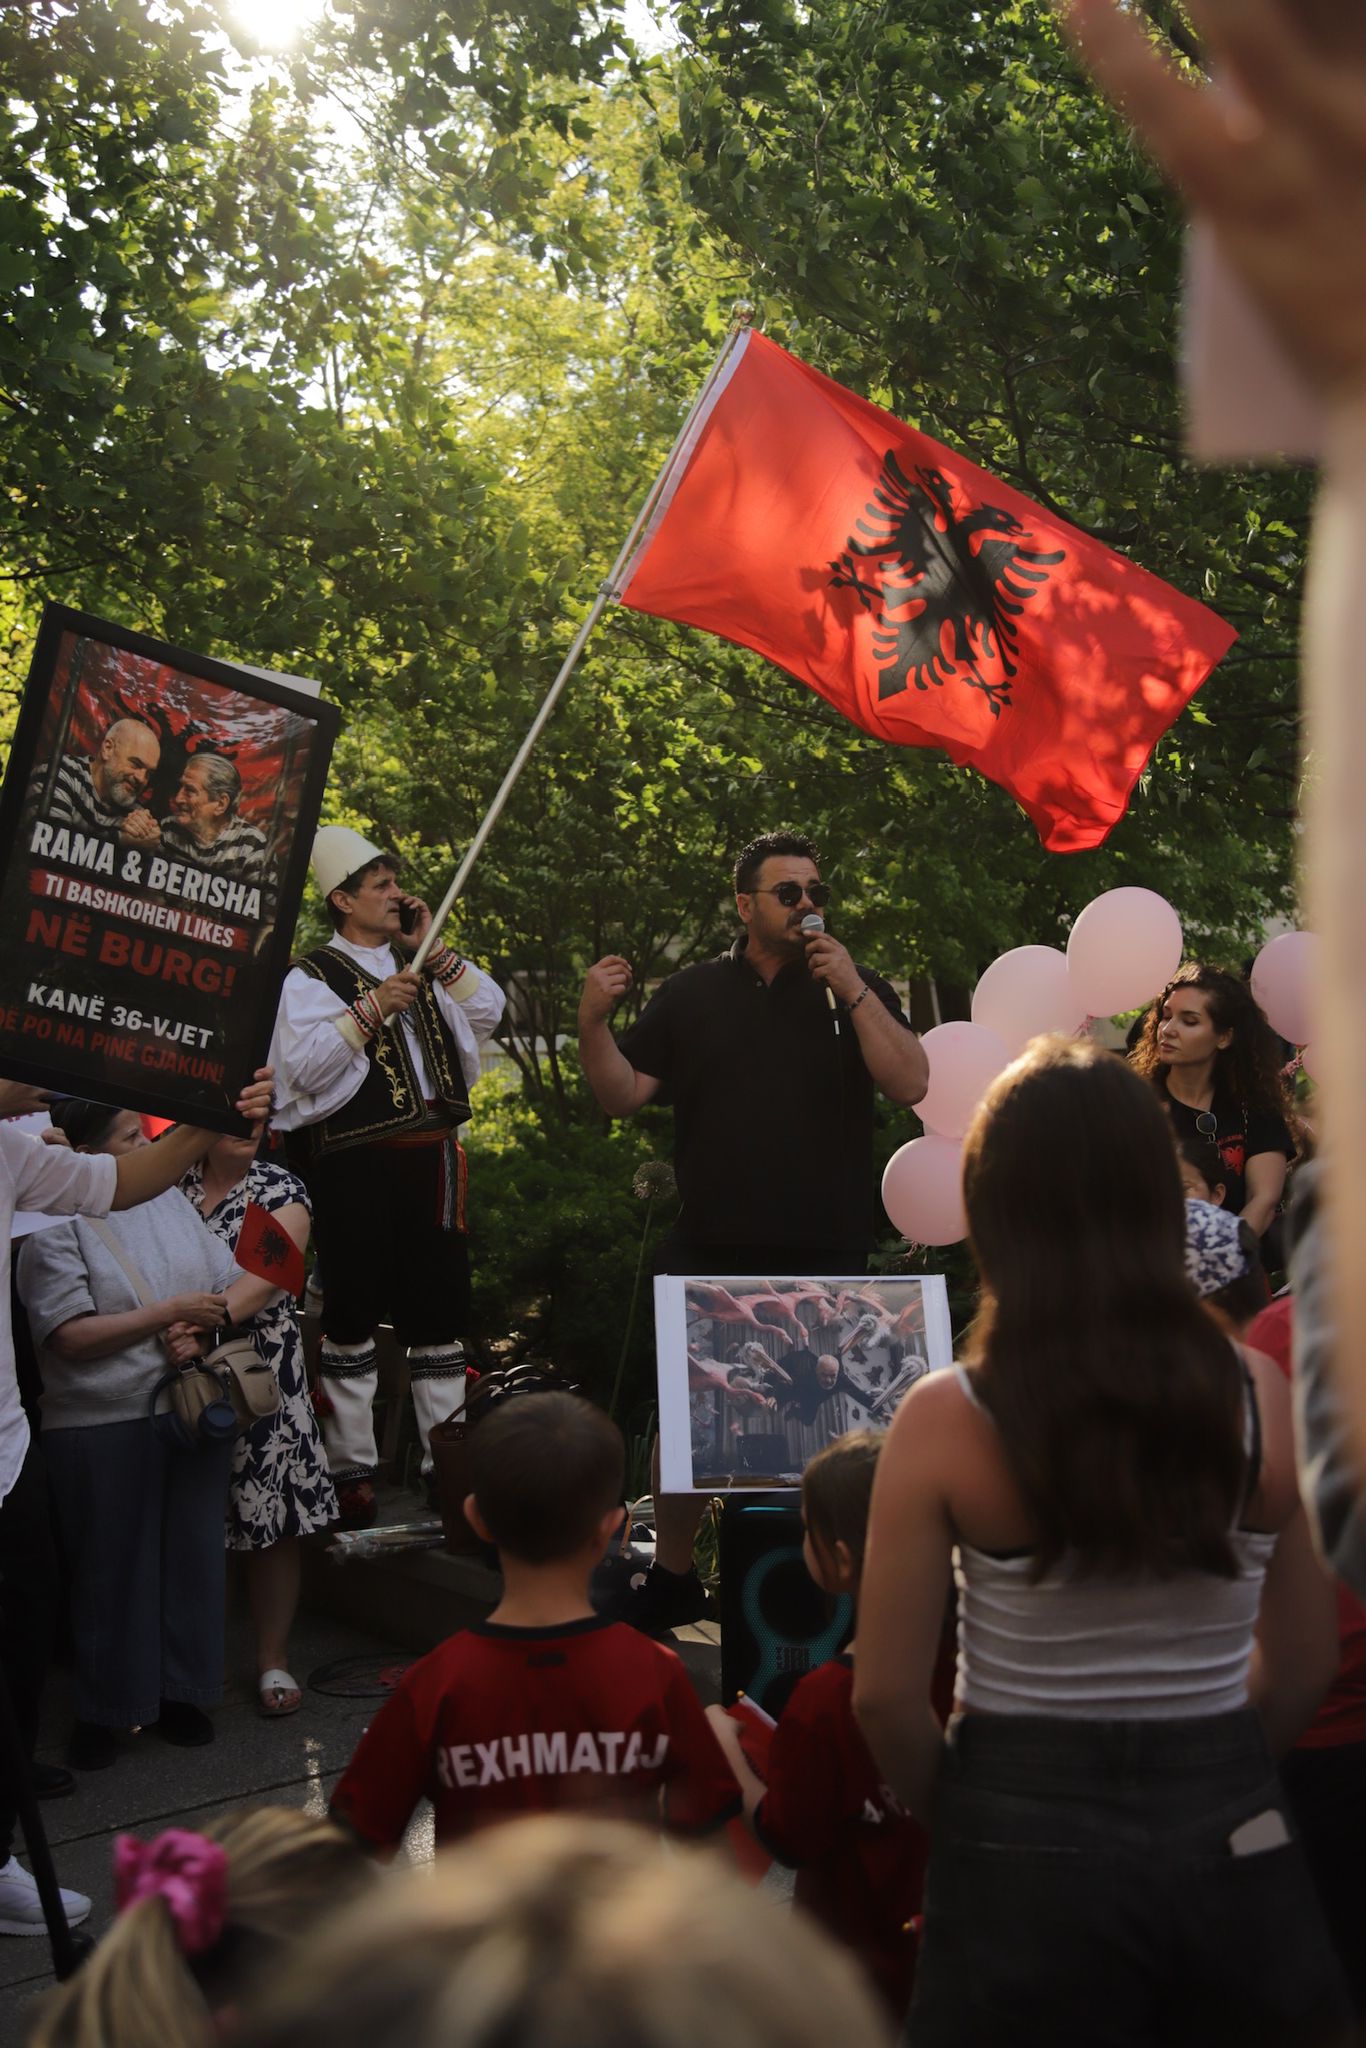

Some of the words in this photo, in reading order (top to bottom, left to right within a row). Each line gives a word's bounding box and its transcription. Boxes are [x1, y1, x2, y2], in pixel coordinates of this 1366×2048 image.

[30, 821, 116, 876] RAMA
[121, 850, 142, 884] &
[147, 857, 262, 921] BERISHA
[45, 873, 64, 898] TI
[66, 881, 181, 932] BASHKOHEN
[183, 919, 235, 949] LIKES
[25, 908, 93, 958] NË
[98, 929, 237, 998] BURG!
[22, 1014, 53, 1040] PO
[56, 1025, 84, 1050] NA
[90, 1031, 137, 1064] PINË
[140, 1045, 226, 1084] GJAKUN!
[27, 982, 105, 1021] KANË
[110, 1006, 214, 1049] 36-VJET
